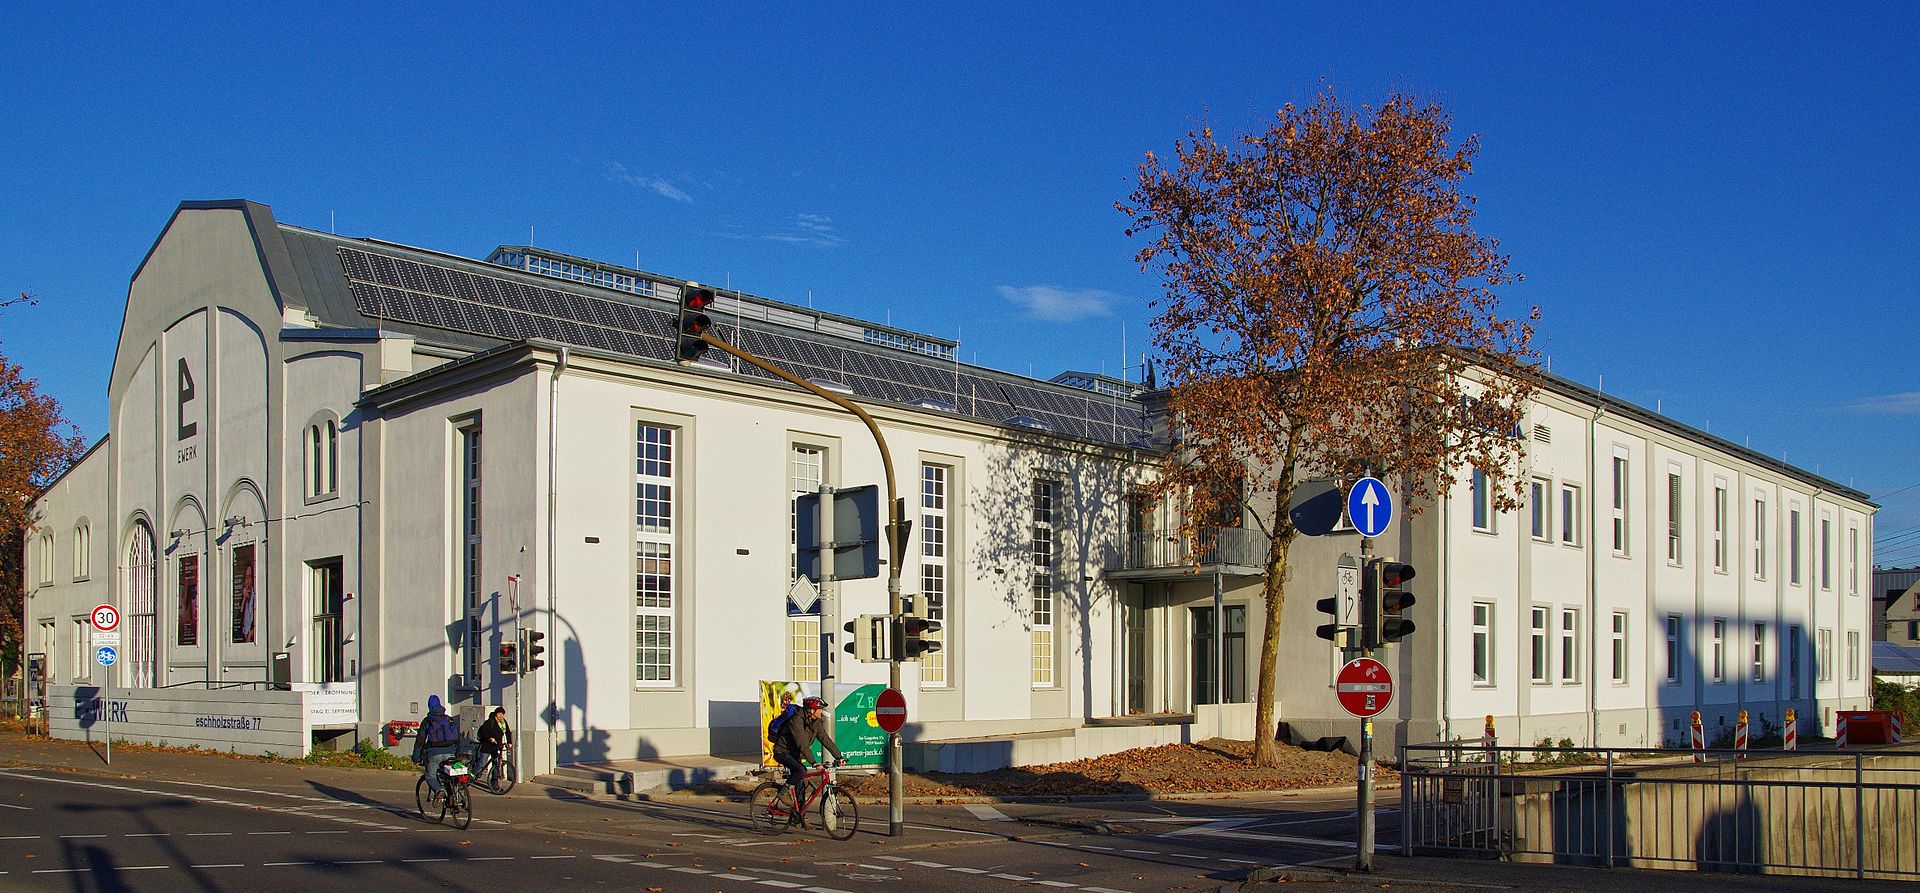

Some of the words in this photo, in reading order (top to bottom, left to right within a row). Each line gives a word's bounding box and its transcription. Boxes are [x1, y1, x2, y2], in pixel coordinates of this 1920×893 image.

[178, 444, 197, 464] EWERK
[97, 612, 114, 624] 30
[195, 715, 249, 729] eschholzstraße
[252, 717, 262, 730] 77
